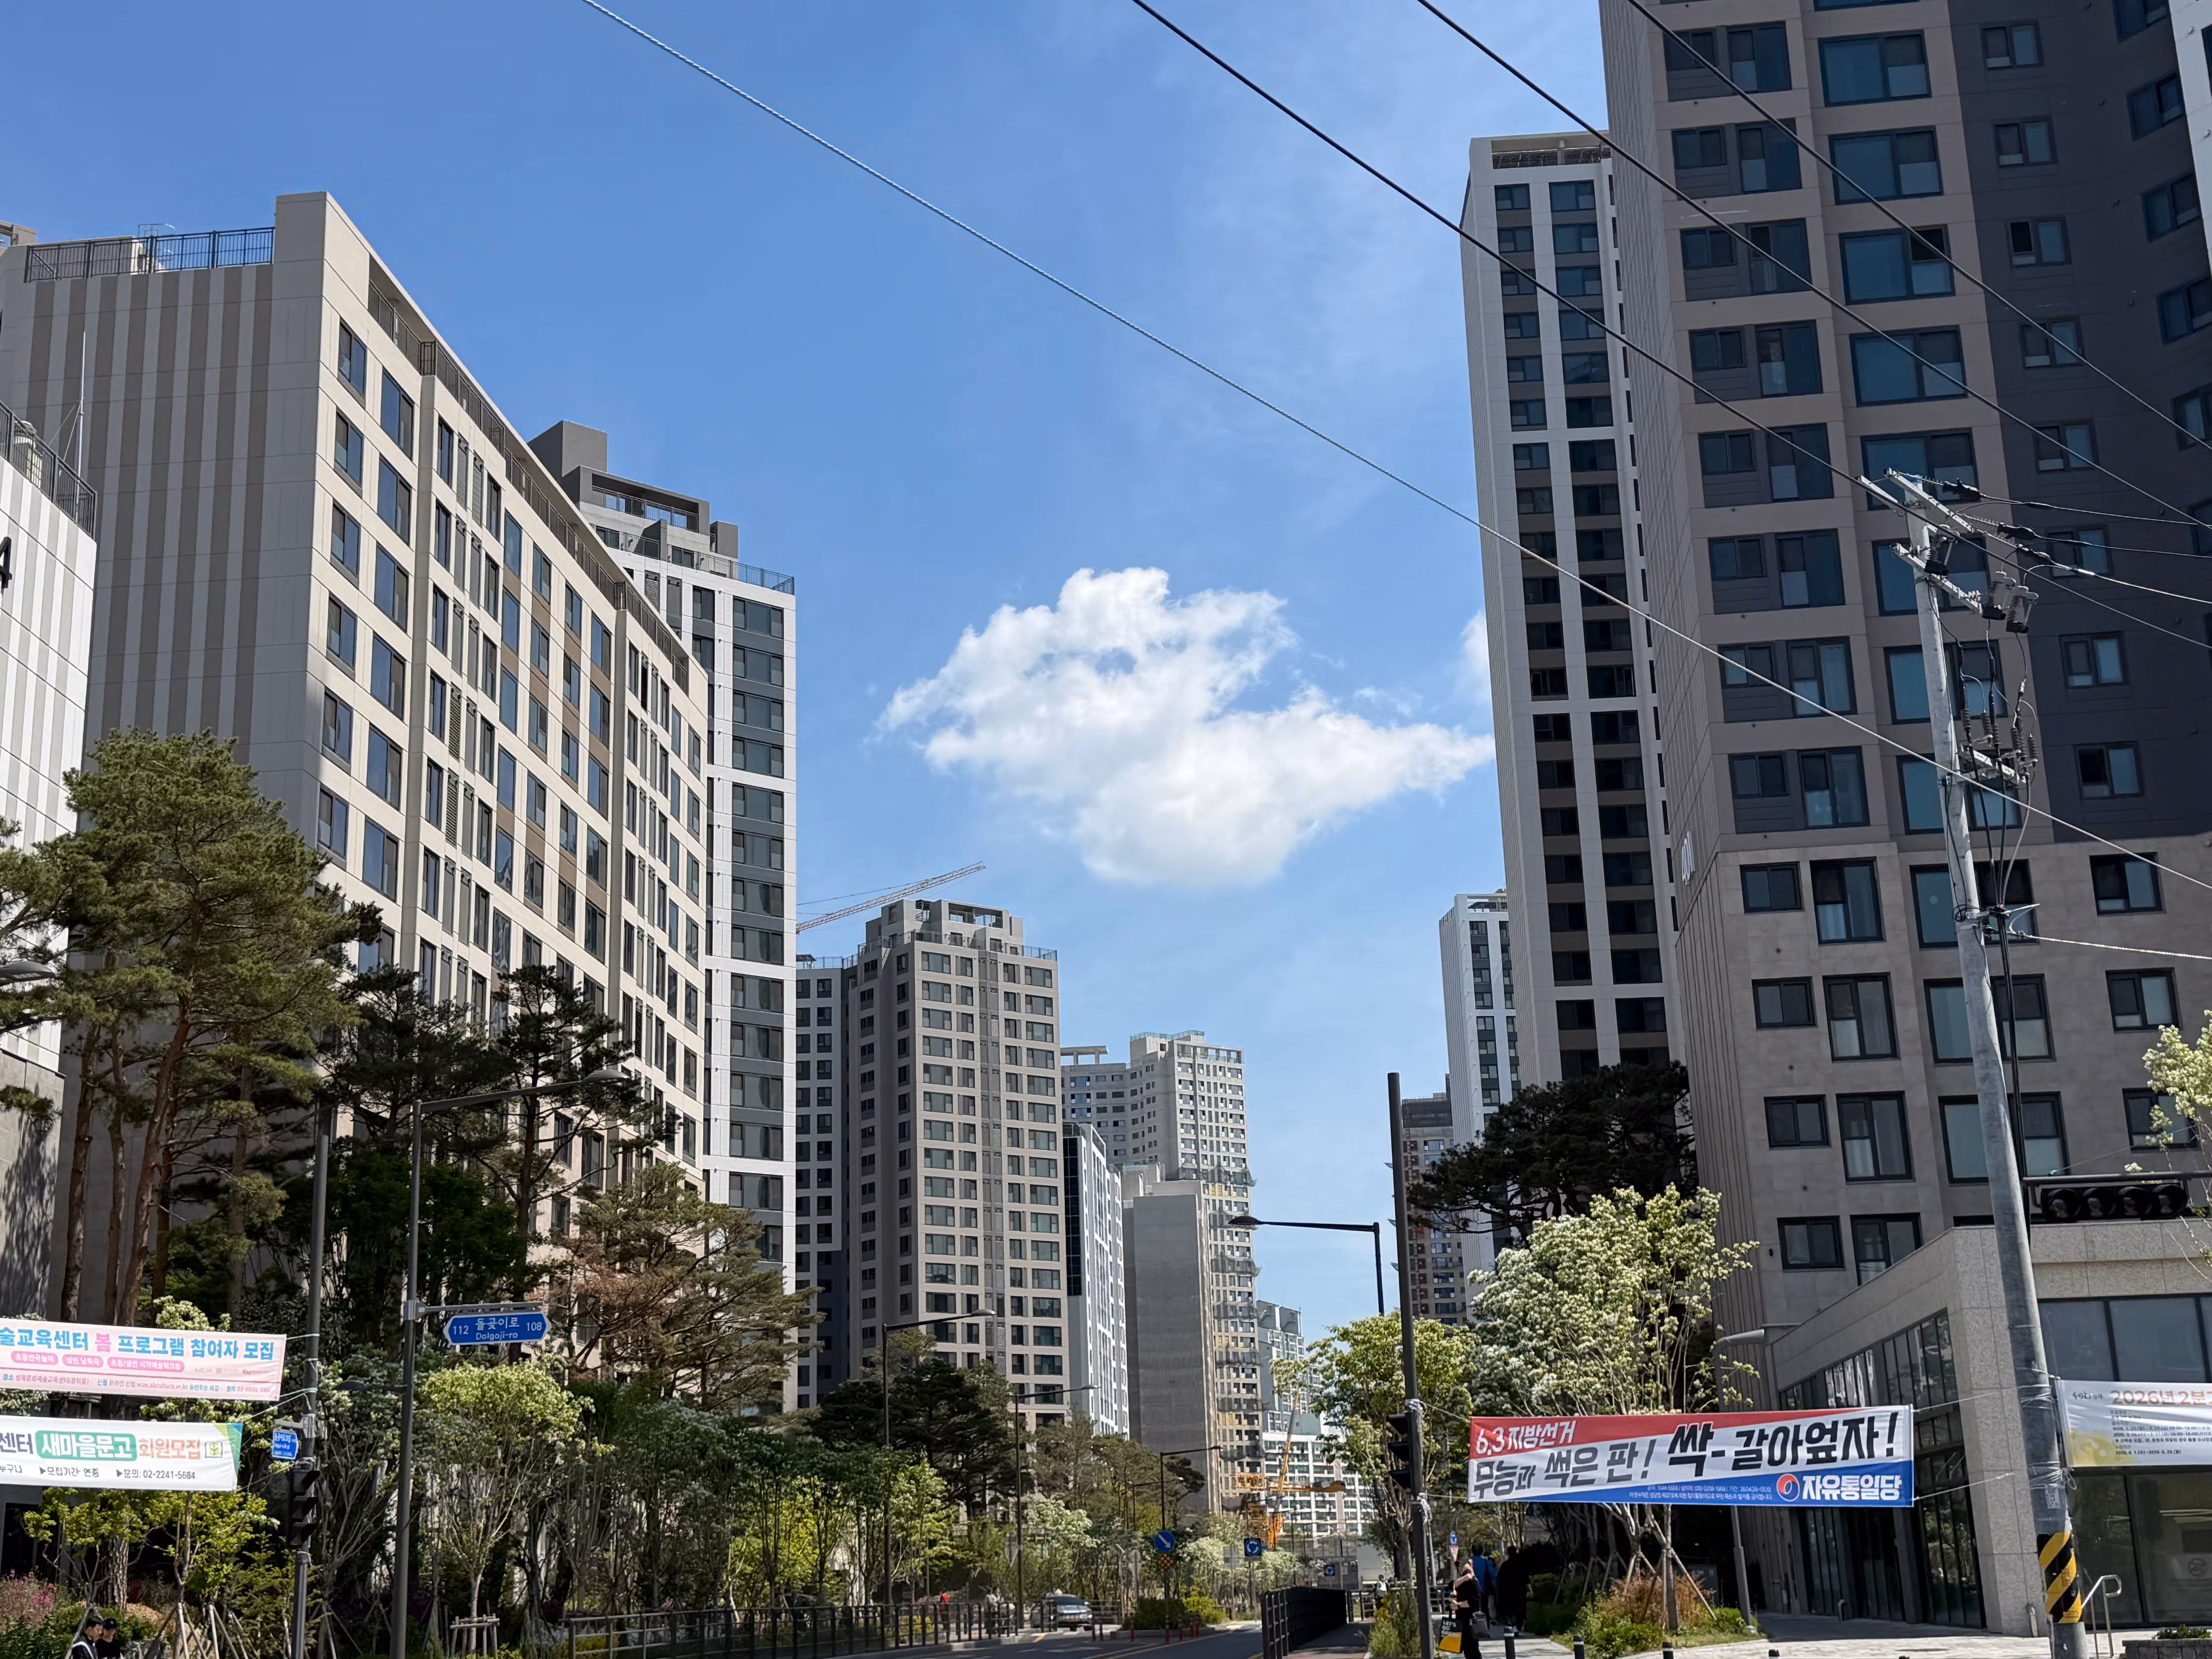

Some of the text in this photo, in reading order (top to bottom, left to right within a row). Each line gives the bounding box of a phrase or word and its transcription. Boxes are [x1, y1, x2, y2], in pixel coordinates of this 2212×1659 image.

[453, 1317, 542, 1335] 112 돌곶이로 108
[476, 1332, 518, 1341] Dolgoji-ro
[0, 1327, 274, 1360] 술교육센터 봄 프로그램 참여자 모집
[2110, 1390, 2176, 1405] 2026년
[0, 1432, 201, 1459] 센터 새마을문고 회원모집
[47, 1466, 81, 1476] 모집기간
[84, 1468, 99, 1478] 연중
[143, 1470, 196, 1479] 02-2241-5684
[1474, 1460, 1536, 1499] 무능과
[1544, 1446, 1598, 1488] 썩은
[1606, 1439, 1657, 1483] 판!
[1802, 1475, 1902, 1501] 자유통일당
